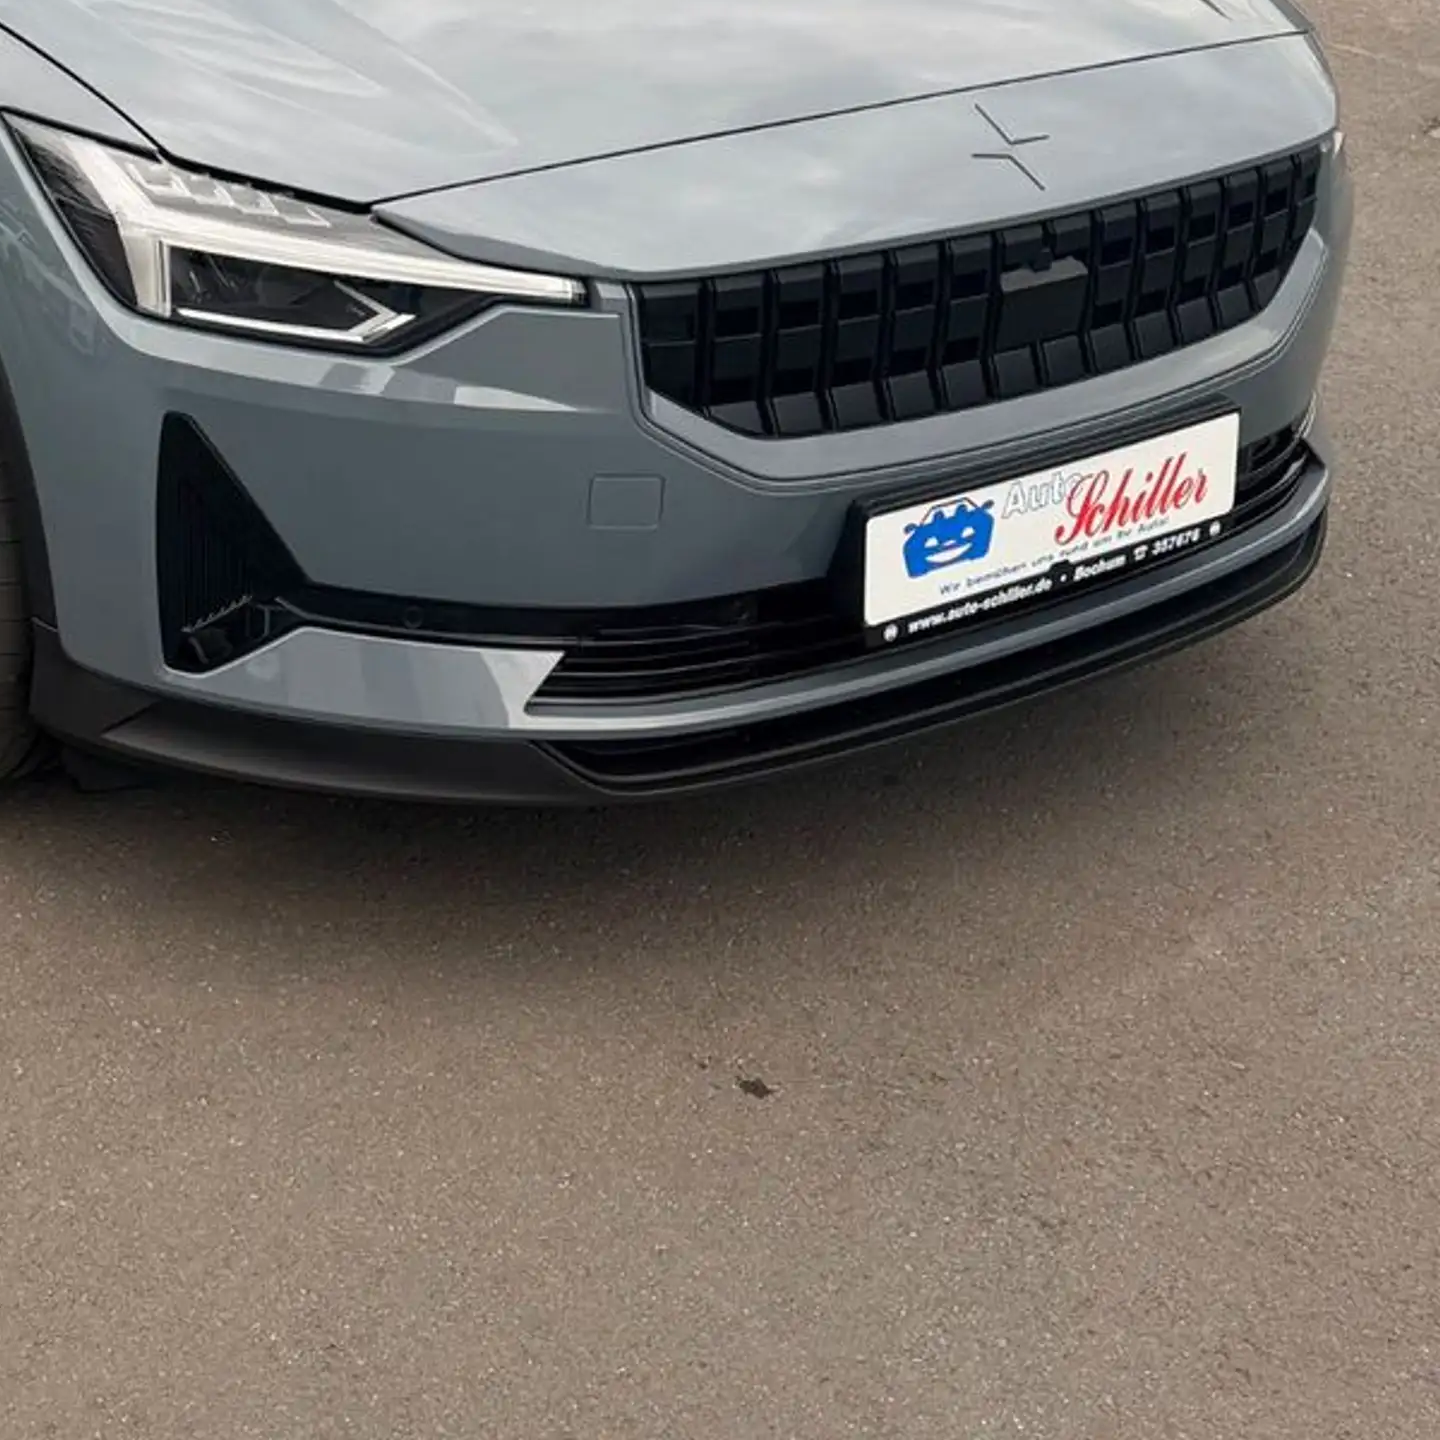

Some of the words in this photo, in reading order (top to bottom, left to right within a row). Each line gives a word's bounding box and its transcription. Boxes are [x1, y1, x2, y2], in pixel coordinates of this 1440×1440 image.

[1001, 472, 1084, 519] Auto
[1054, 452, 1208, 546] Schiller
[907, 577, 1053, 634] www.auto-schiller.de
[1073, 553, 1127, 582] Bochum
